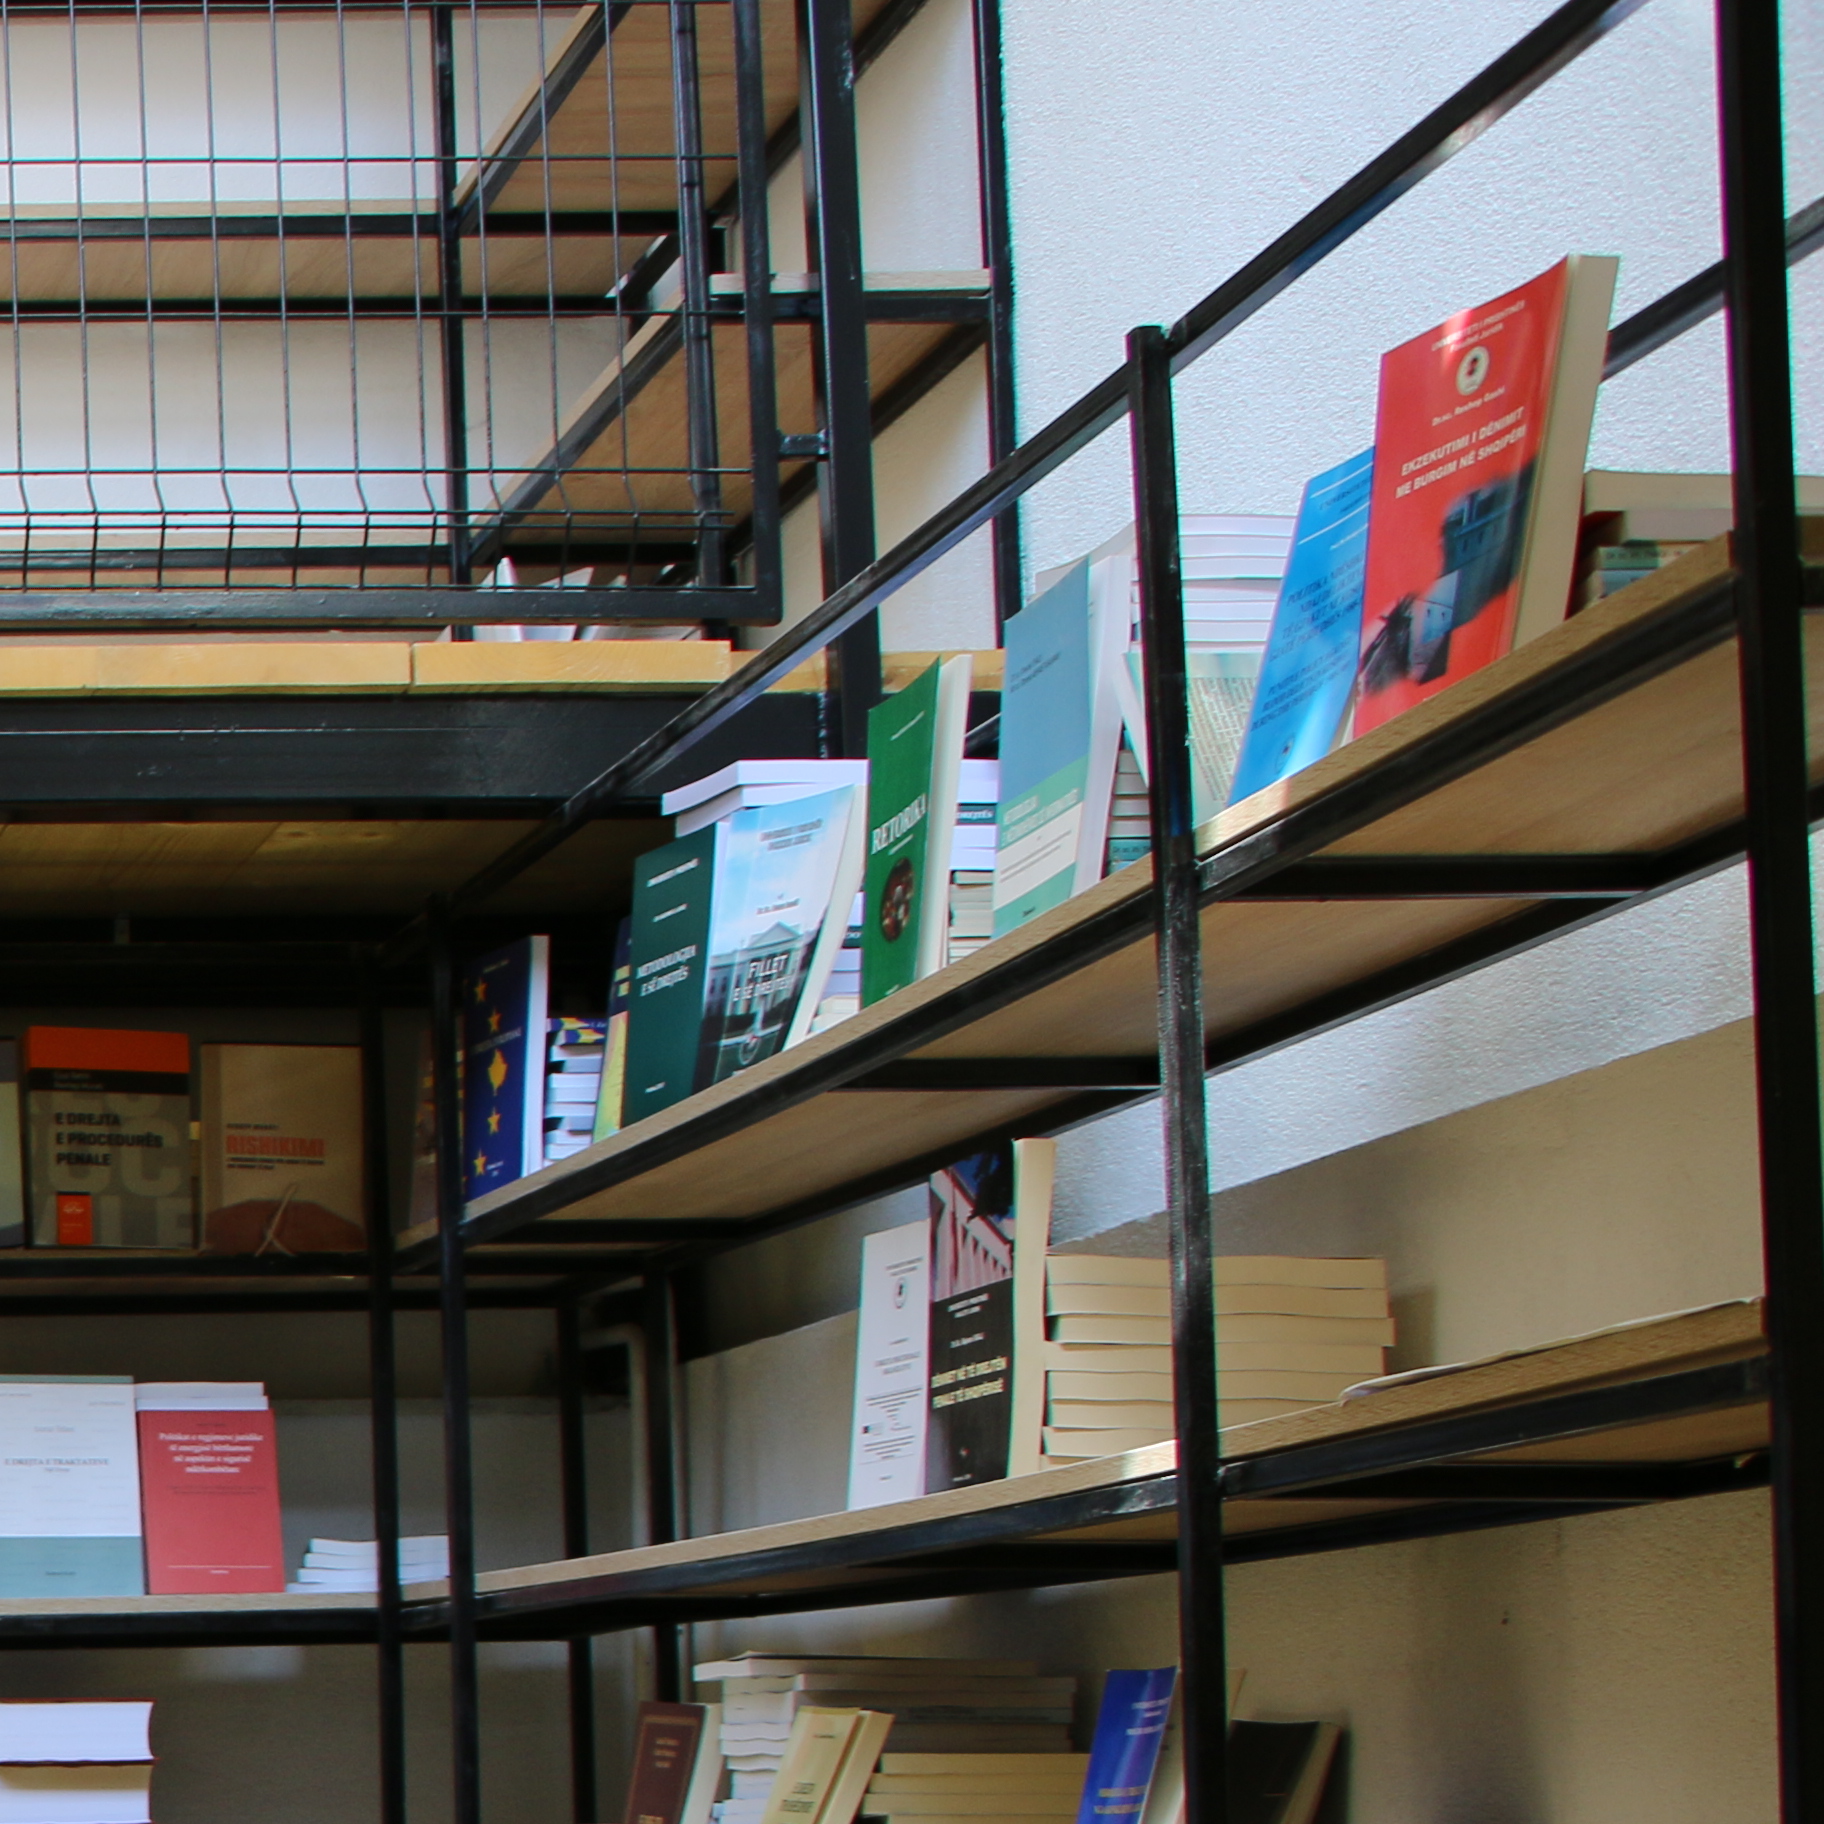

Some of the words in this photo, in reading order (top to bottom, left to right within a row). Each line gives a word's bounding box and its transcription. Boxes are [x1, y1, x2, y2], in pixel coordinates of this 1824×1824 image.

[1402, 435, 1470, 476] EKZEKUTIMI
[1481, 406, 1525, 438] DËNIMIT
[1395, 482, 1412, 500] ME
[1414, 461, 1456, 493] BURGIM
[1459, 451, 1475, 470] NË
[871, 794, 927, 854] RETORIKA
[749, 953, 789, 977] FILLET
